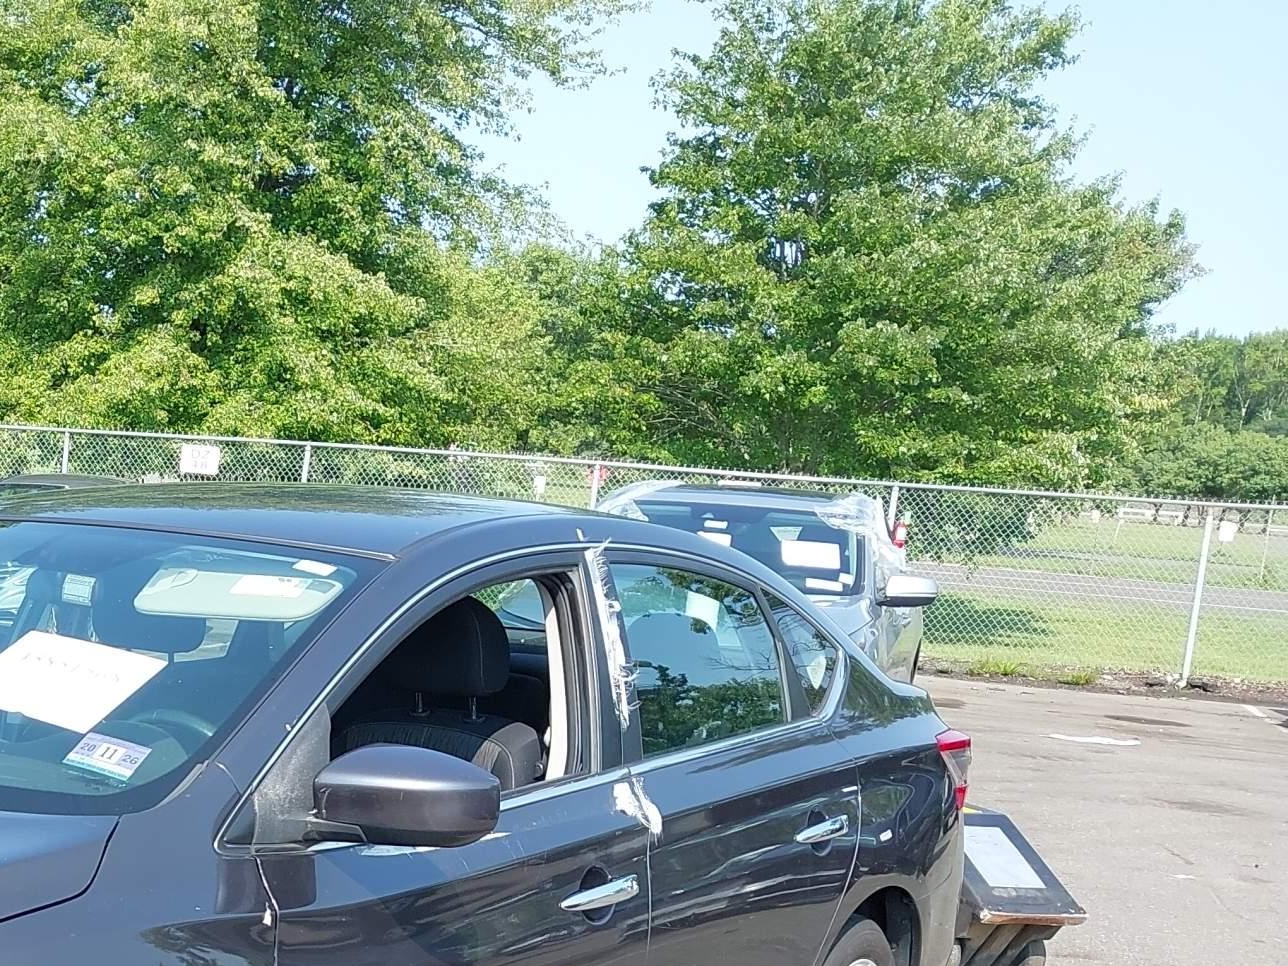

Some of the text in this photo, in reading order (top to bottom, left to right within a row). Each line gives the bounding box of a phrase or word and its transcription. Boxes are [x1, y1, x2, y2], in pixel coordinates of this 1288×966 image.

[80, 742, 139, 765] 20 11 26
